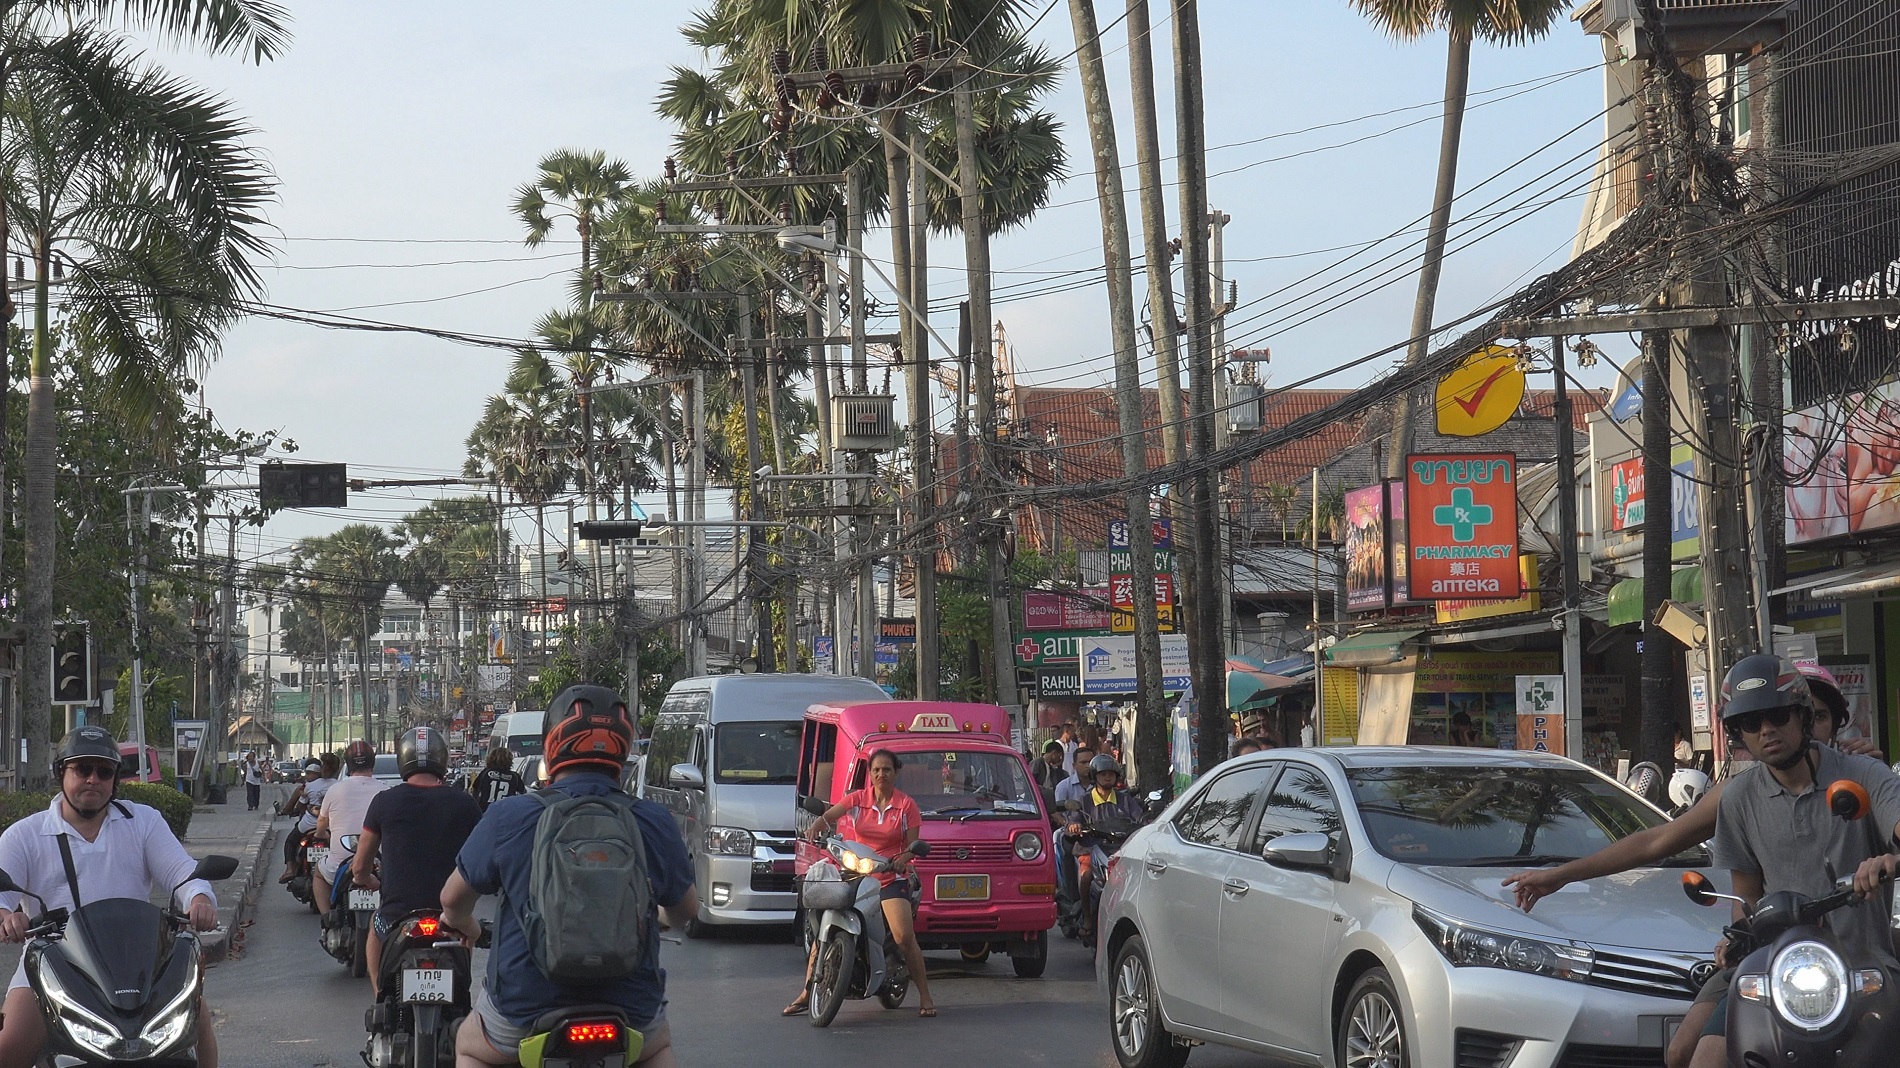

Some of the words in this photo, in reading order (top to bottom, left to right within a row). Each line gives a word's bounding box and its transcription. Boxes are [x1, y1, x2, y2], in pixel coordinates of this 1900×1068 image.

[1413, 459, 1511, 485] ขายยา
[1628, 506, 1645, 524] PHAR
[1416, 545, 1513, 559] PHARMACY
[1431, 578, 1499, 593] аптека
[882, 624, 915, 637] PHUKET
[1043, 637, 1080, 656] апт
[1041, 676, 1080, 689] RAHUL
[1584, 676, 1623, 684] MOTORBIKE
[920, 717, 949, 728] TAXI
[487, 780, 510, 803] 12
[420, 982, 436, 991] ภูเก็ต
[410, 992, 445, 1001] 4662
